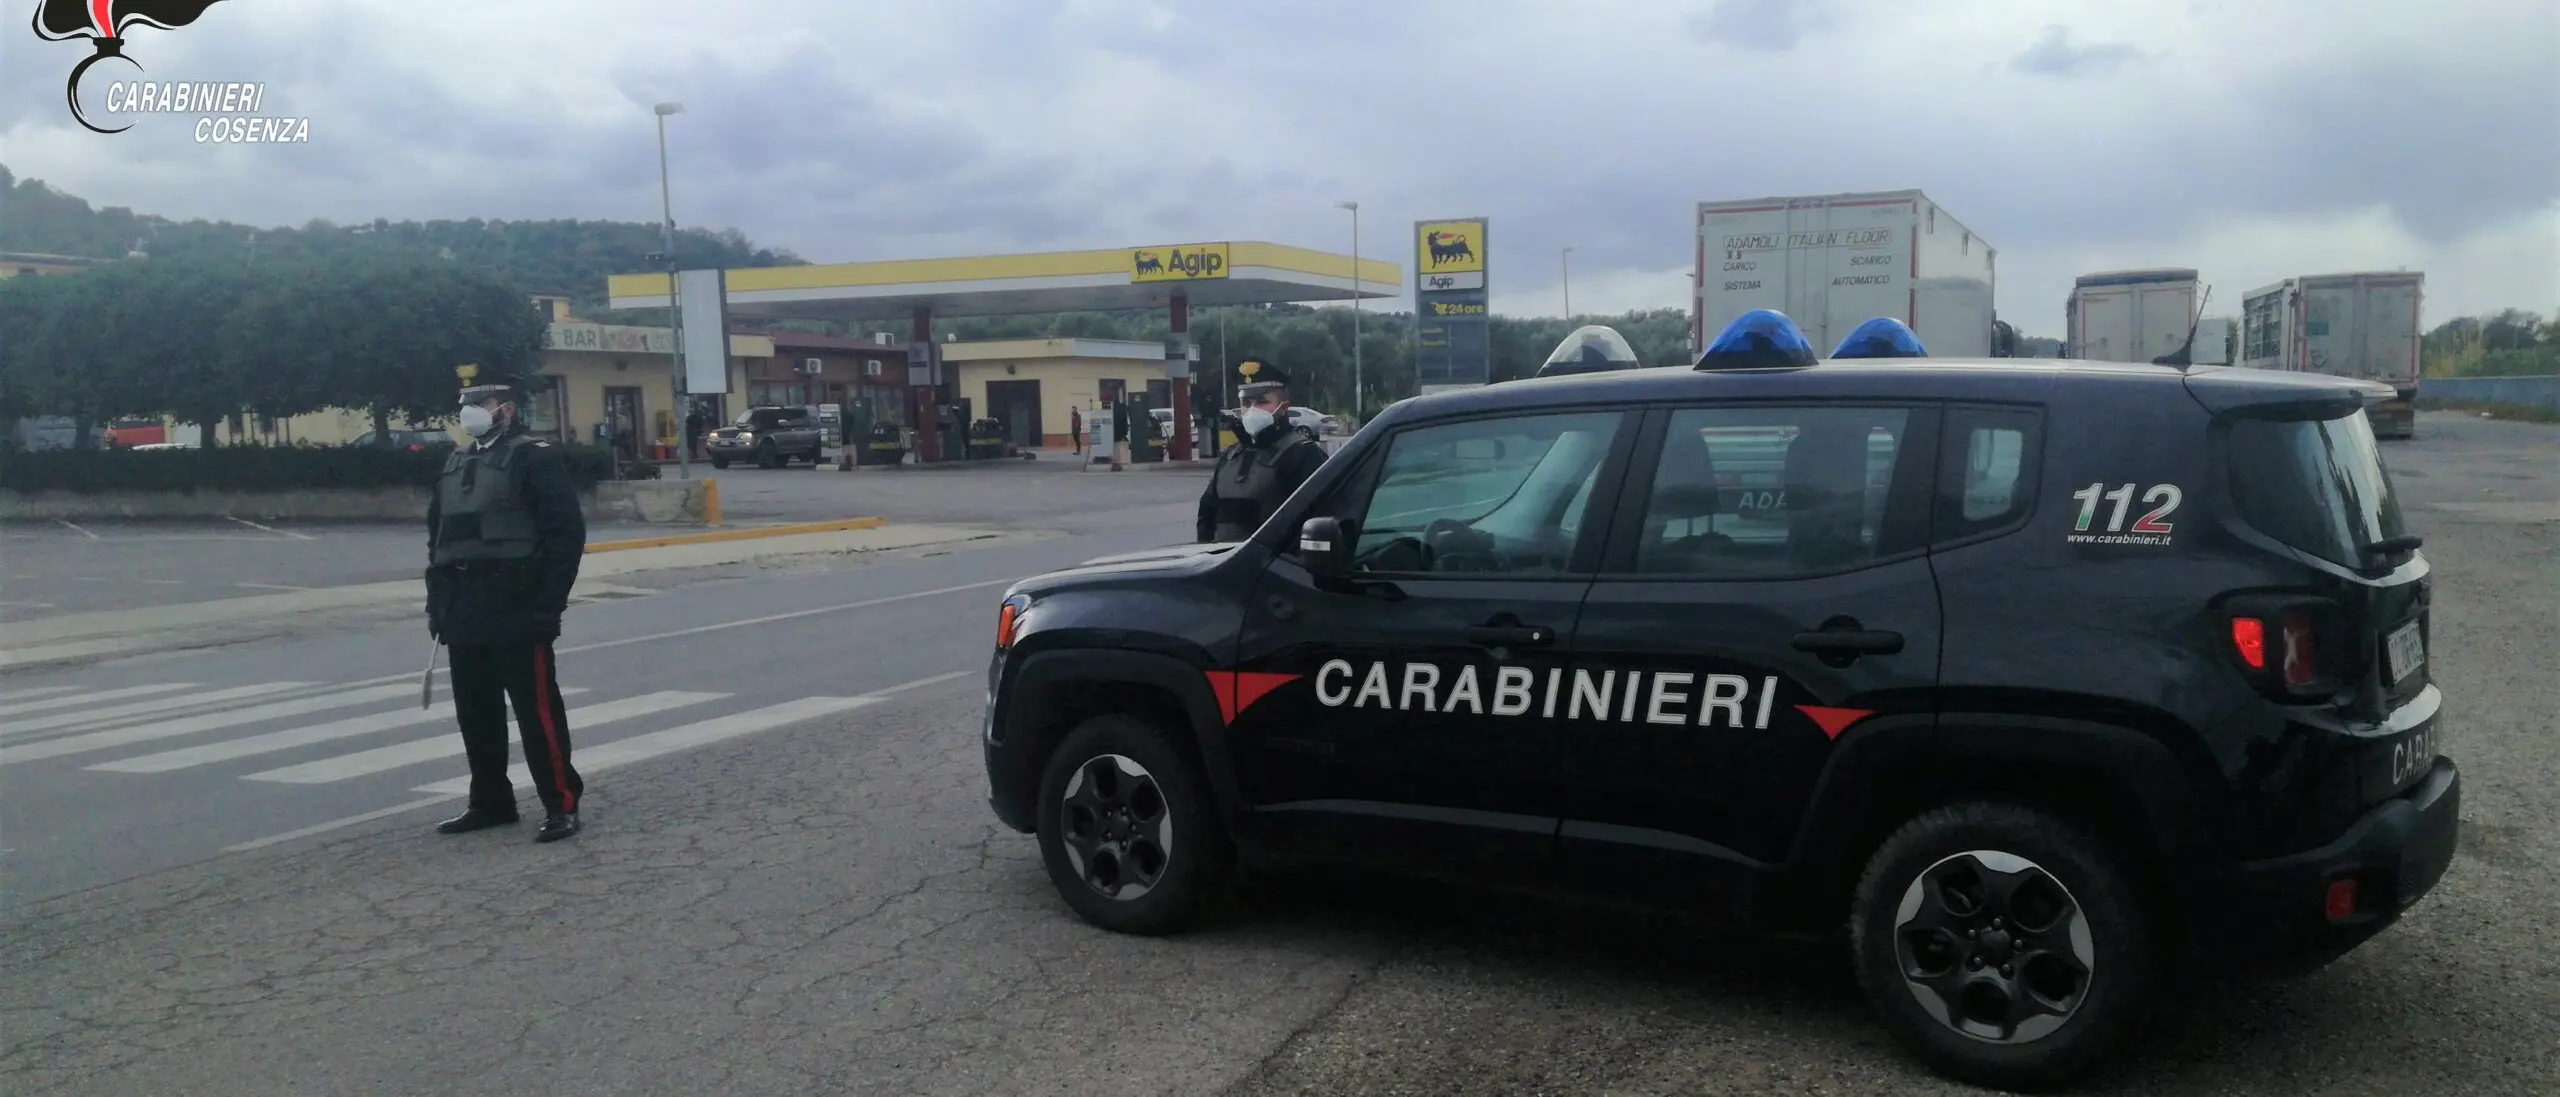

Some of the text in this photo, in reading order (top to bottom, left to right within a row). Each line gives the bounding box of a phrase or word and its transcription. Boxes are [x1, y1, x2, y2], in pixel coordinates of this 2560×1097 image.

[1726, 235, 1780, 249] ADAMOLI
[1845, 229, 1889, 244] FLOOR
[1168, 247, 1222, 277] Agip
[1723, 261, 1757, 272] CARICO
[1850, 255, 1892, 267] SCARICO
[1429, 275, 1454, 289] Agip
[1724, 281, 1761, 291] SISTEMA
[1831, 275, 1890, 286] AUTOMATICO
[563, 328, 597, 348] BAR
[2073, 482, 2182, 533] 112
[2067, 534, 2172, 546] www.carabinieri.it
[1315, 658, 1778, 729] CARABINIERI
